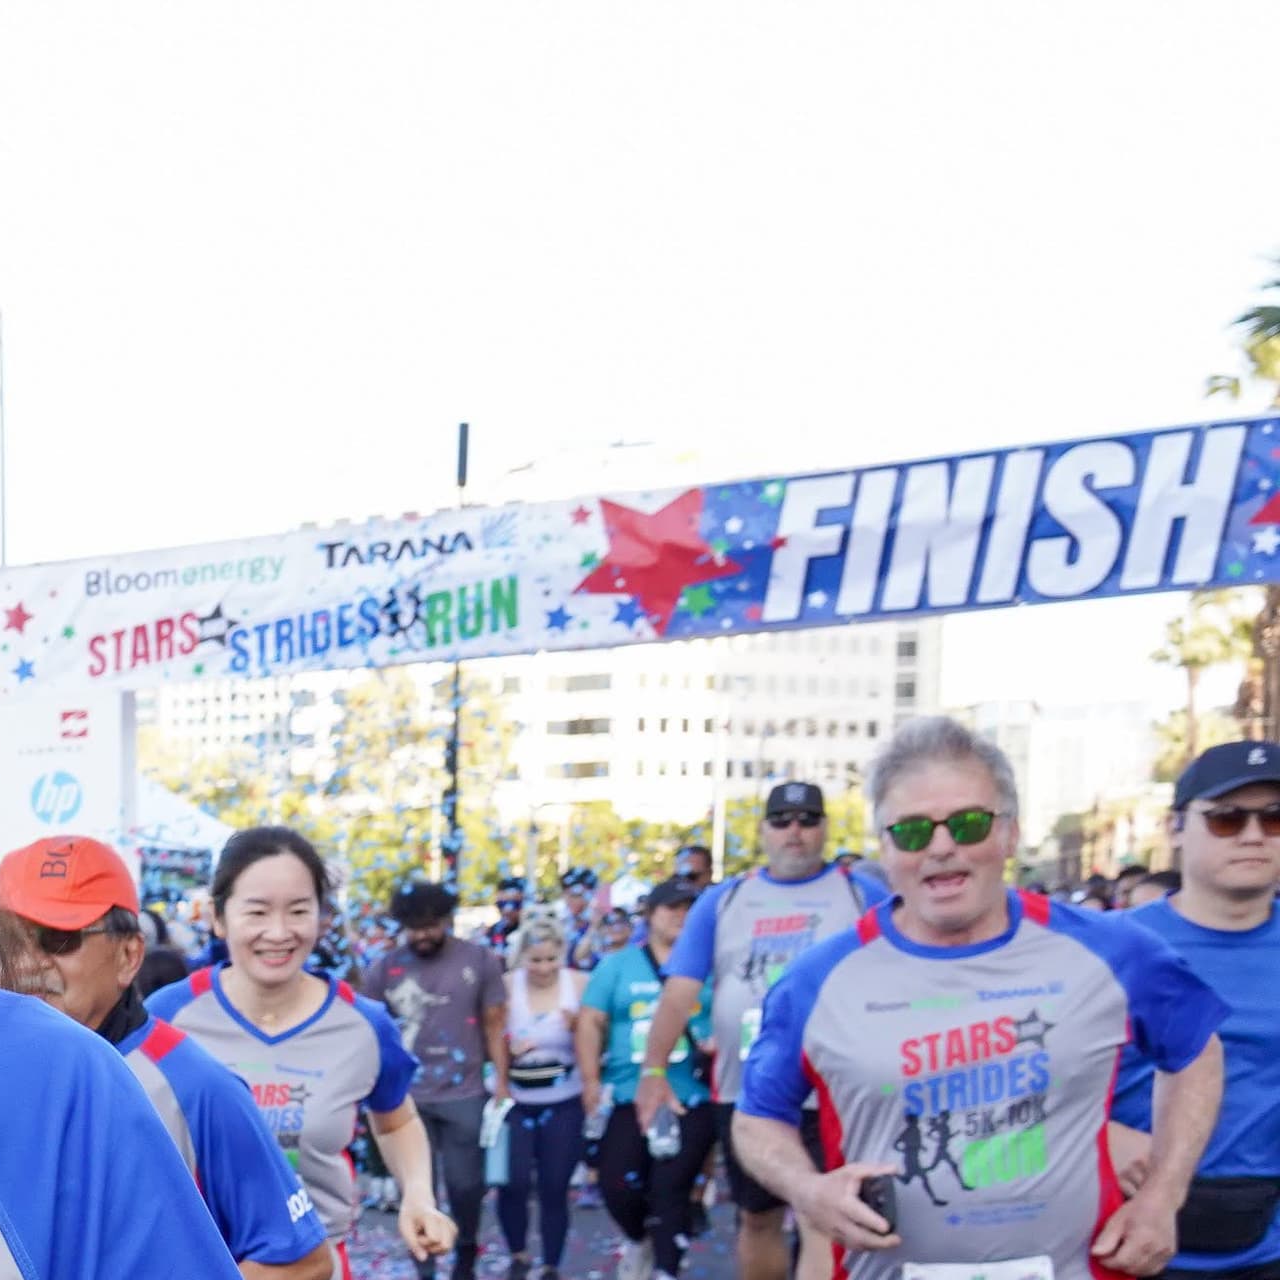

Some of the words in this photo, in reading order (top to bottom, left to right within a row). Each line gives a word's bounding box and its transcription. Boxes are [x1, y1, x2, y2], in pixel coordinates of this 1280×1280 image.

[323, 531, 474, 570] TARANA
[762, 425, 1247, 623] FINISH
[87, 610, 202, 678] STARS
[229, 596, 383, 673] STRIDES
[423, 575, 521, 649] RUN
[900, 1016, 1019, 1077] STARS
[903, 1051, 1051, 1118] STRIDES
